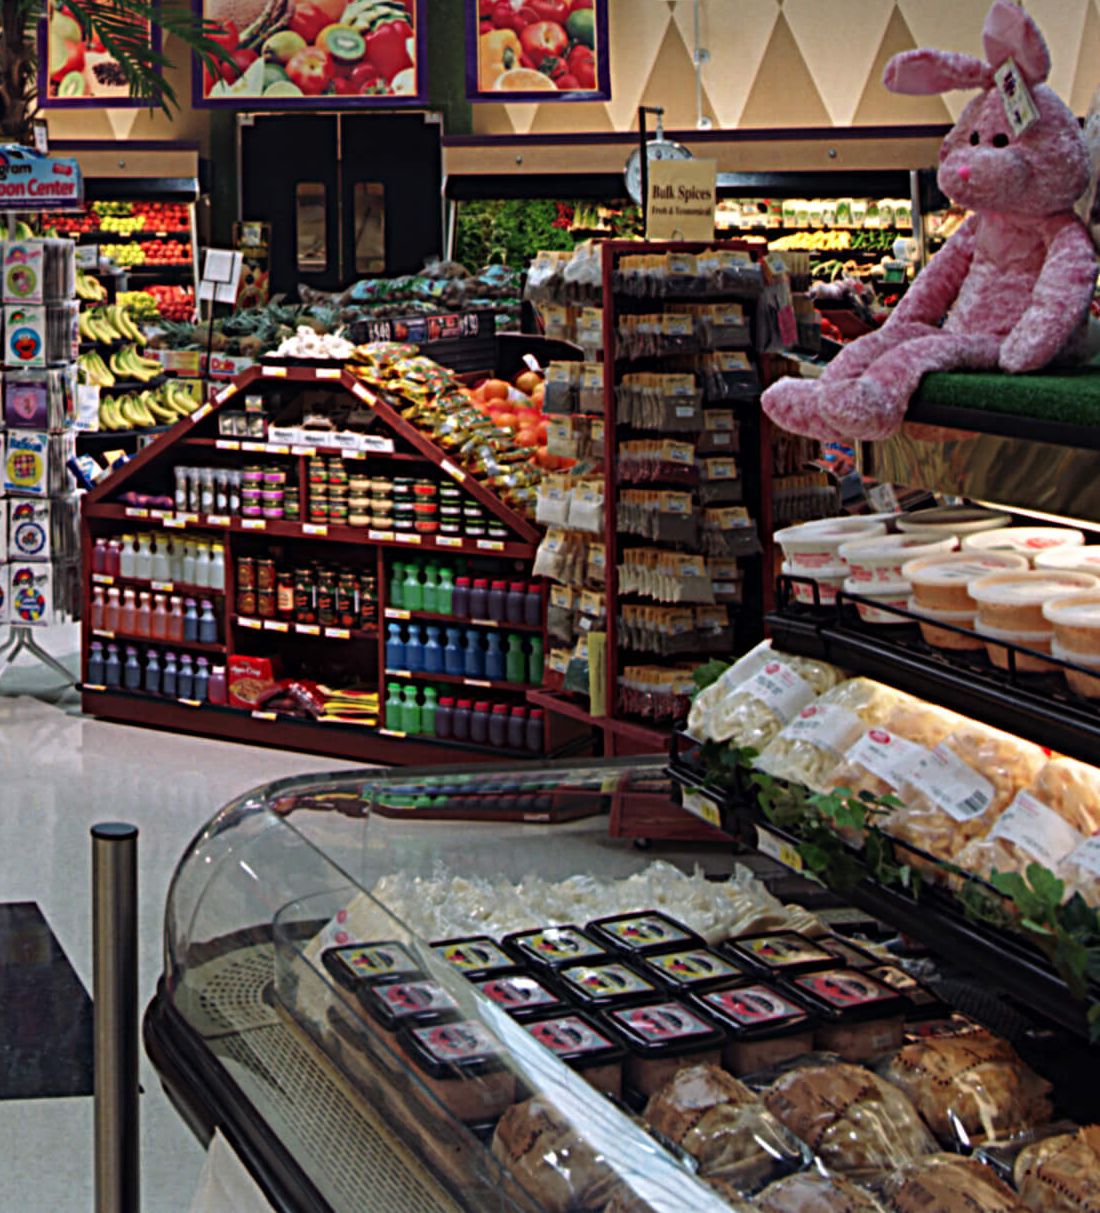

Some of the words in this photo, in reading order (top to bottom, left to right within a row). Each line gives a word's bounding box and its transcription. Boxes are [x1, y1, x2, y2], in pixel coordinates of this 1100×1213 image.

[27, 178, 75, 196] Center
[652, 184, 674, 200] Bulk
[677, 184, 712, 203] Spices
[211, 357, 236, 371] Dole
